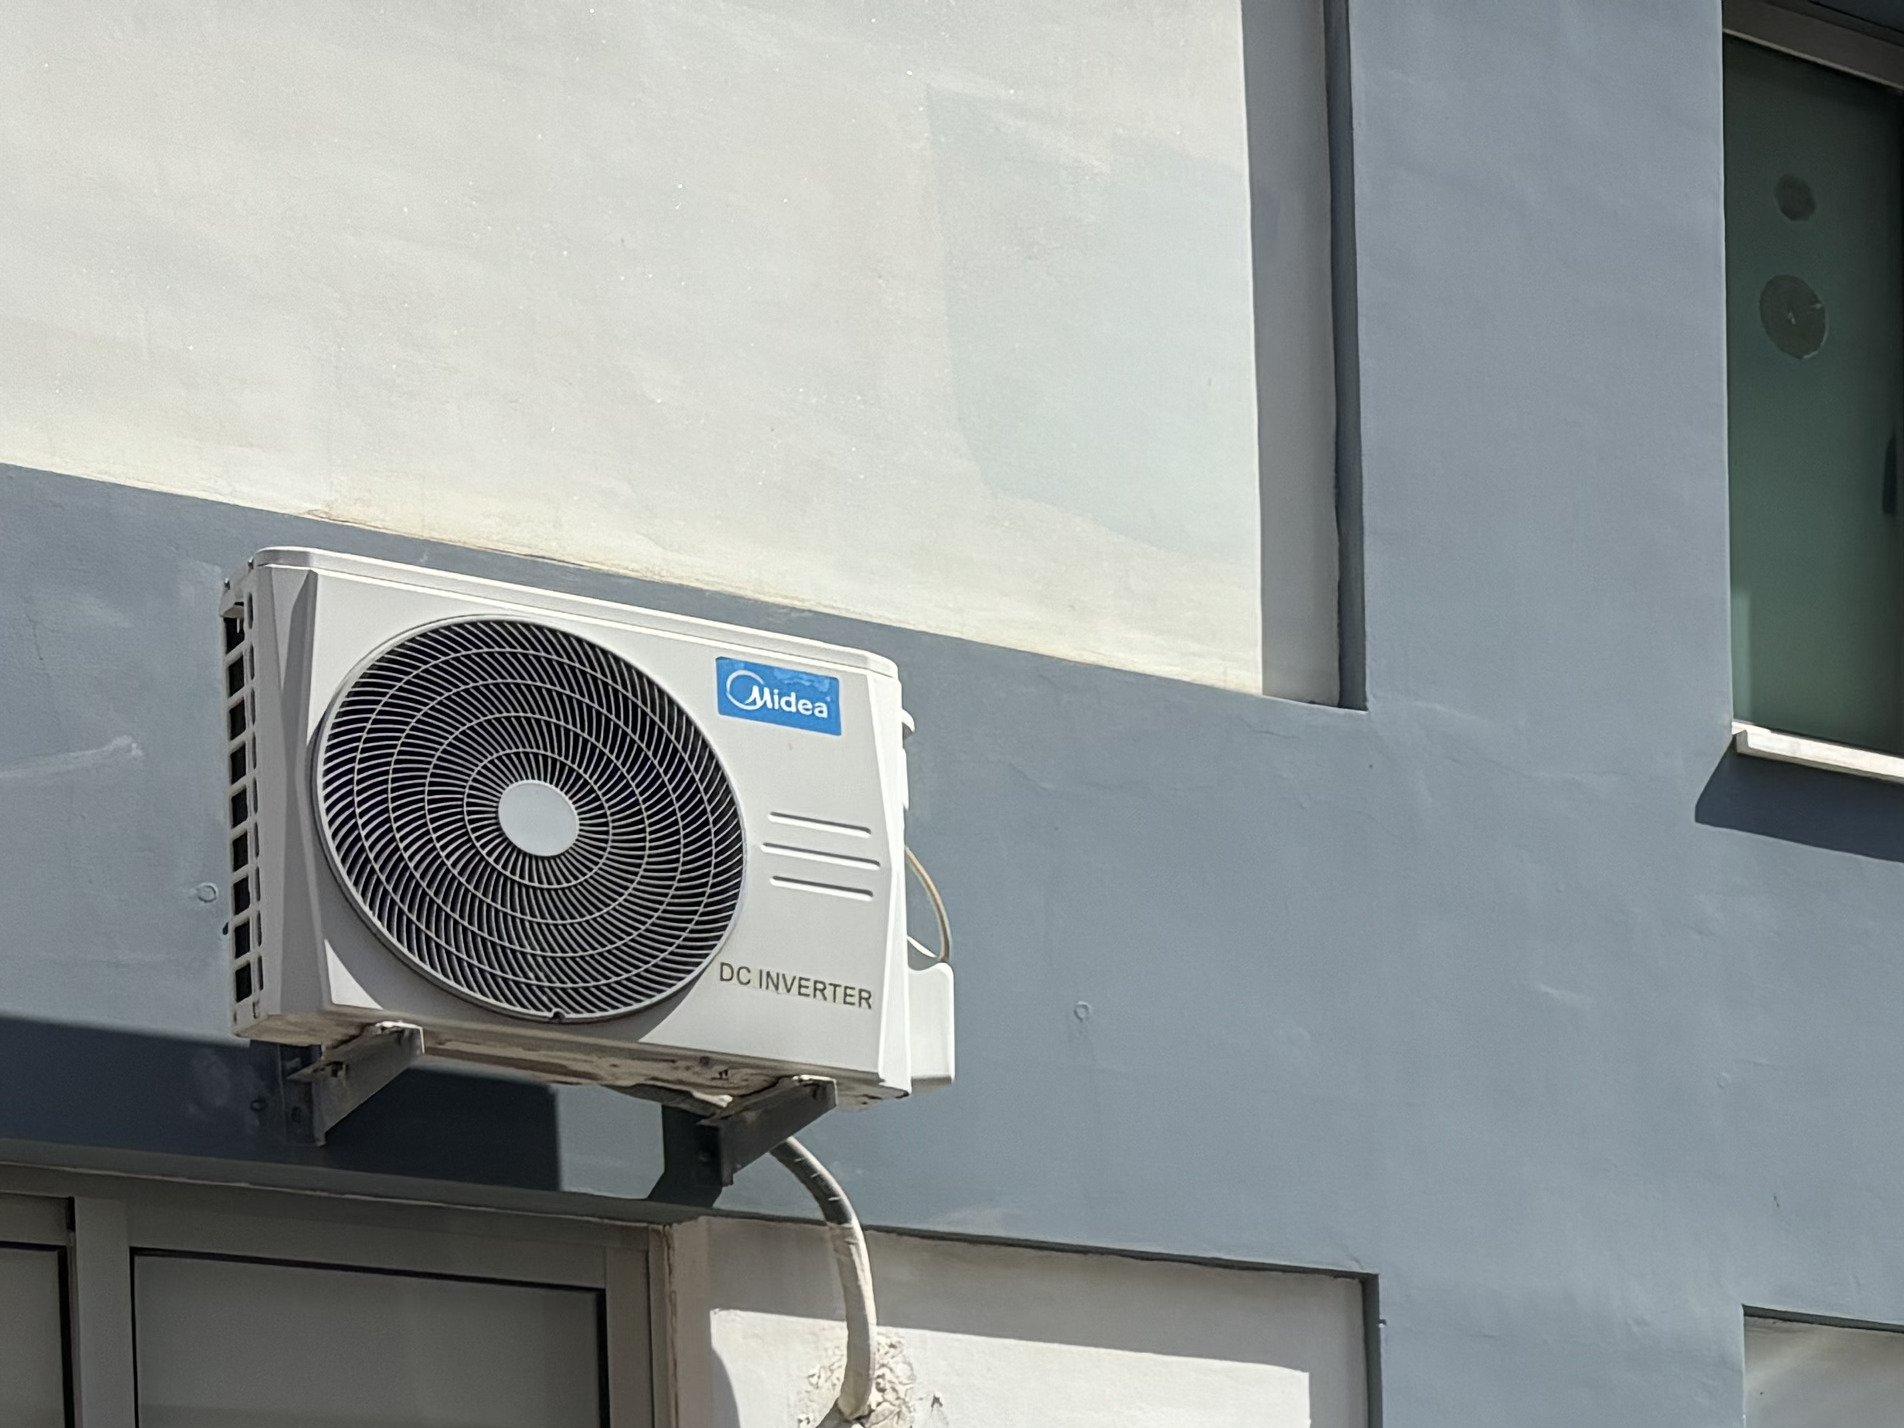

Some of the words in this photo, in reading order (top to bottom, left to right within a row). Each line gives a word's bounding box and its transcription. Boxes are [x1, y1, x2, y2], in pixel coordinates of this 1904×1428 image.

[726, 669, 829, 719] Midea
[719, 961, 751, 986] DC
[758, 969, 873, 1010] INVERTER
